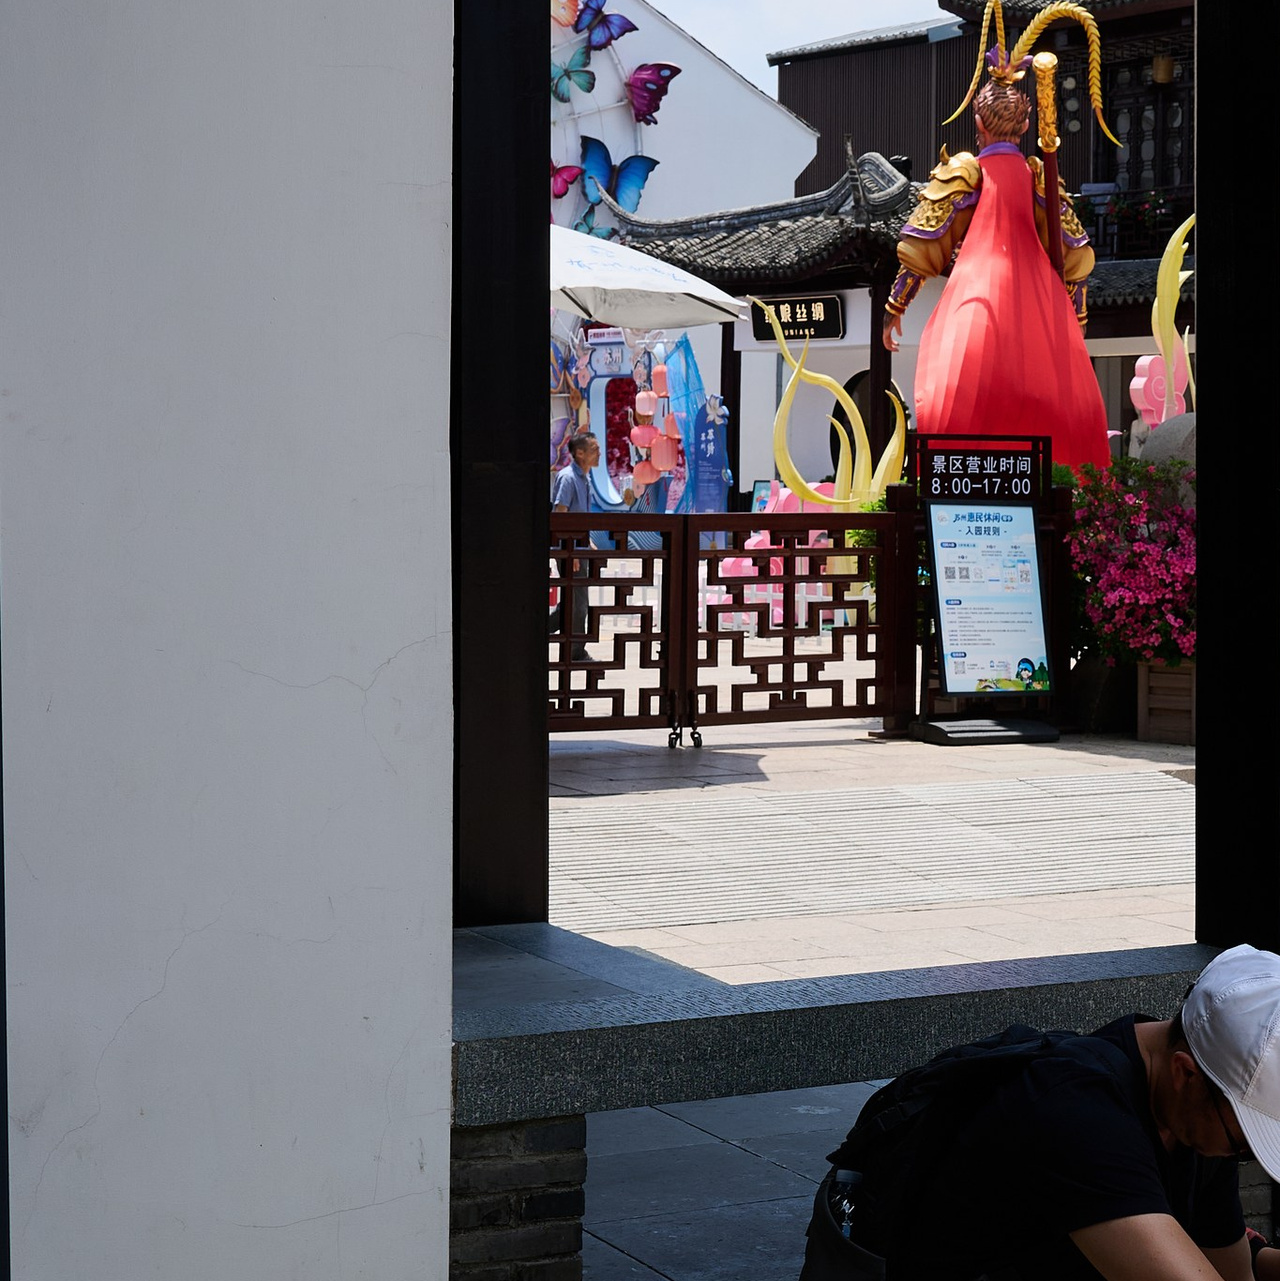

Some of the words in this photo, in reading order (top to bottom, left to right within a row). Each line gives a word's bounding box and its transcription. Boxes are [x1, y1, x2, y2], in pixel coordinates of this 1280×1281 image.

[784, 327, 816, 336] UNIANG
[931, 455, 1032, 475] 景区营业时间
